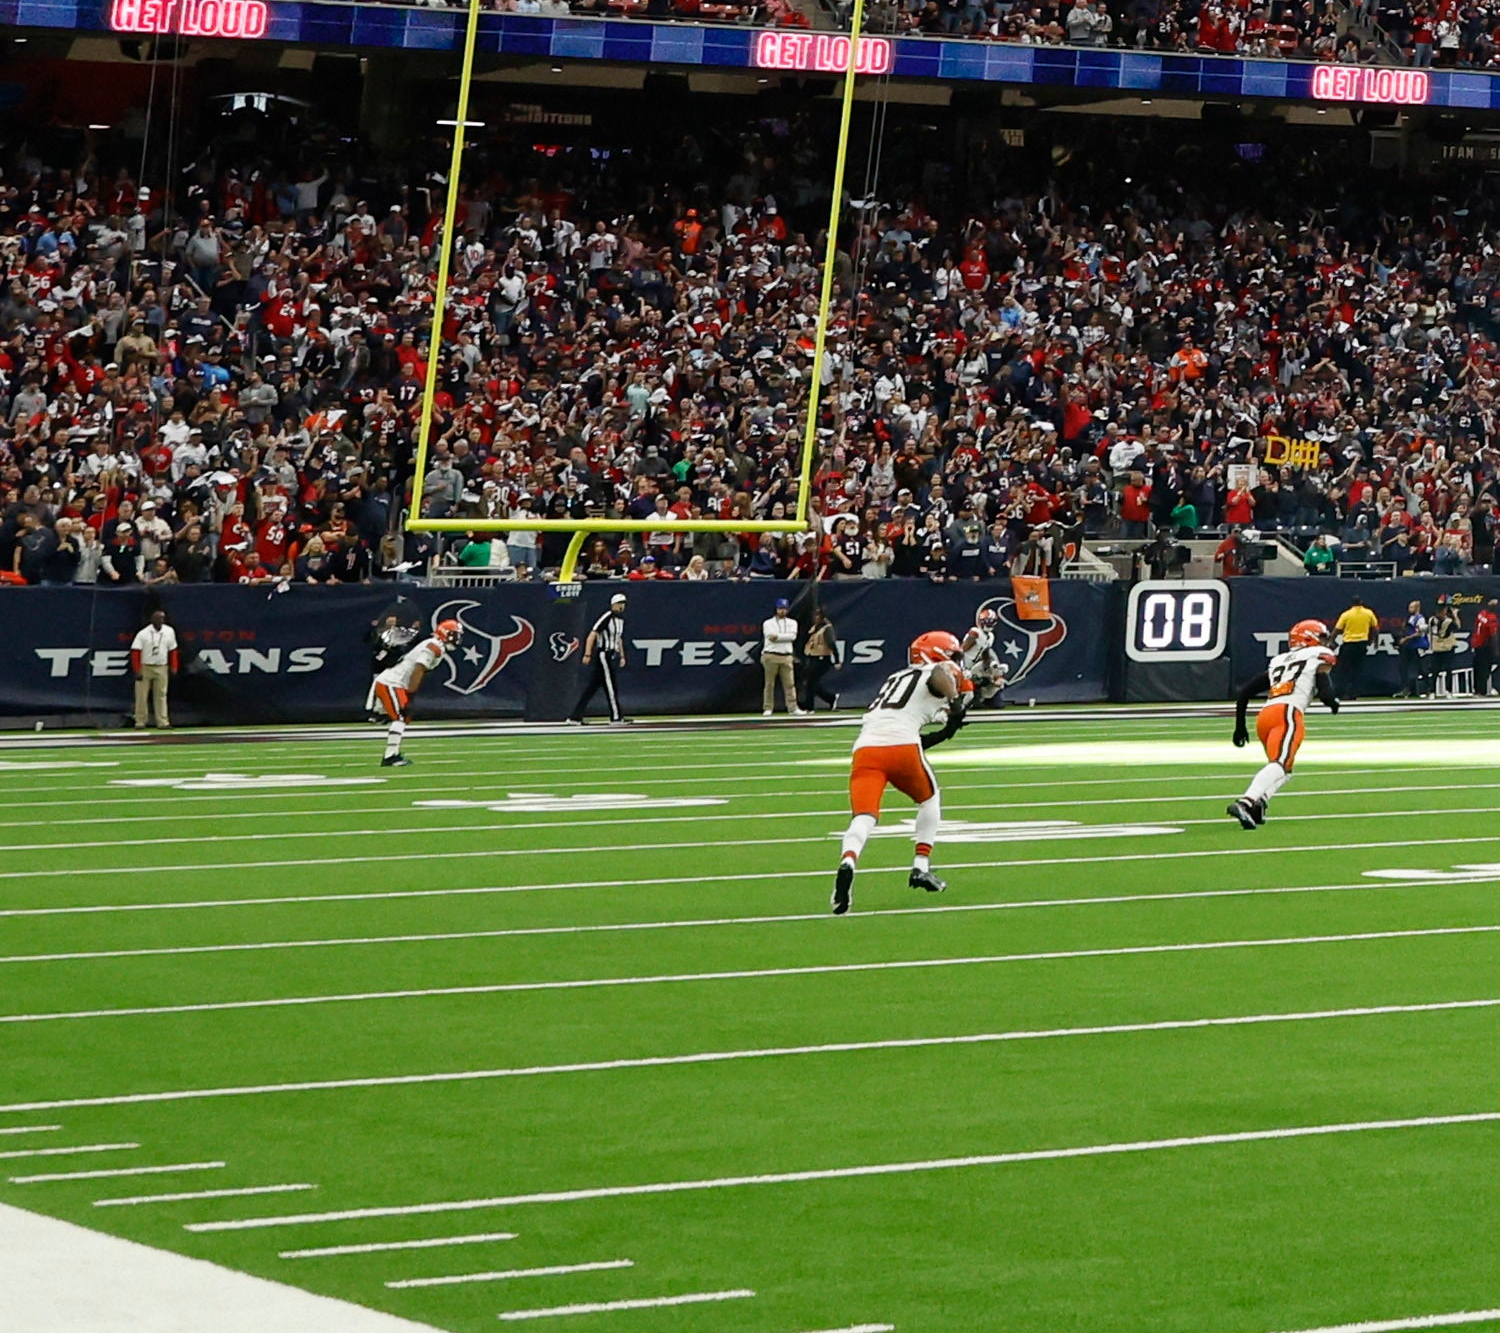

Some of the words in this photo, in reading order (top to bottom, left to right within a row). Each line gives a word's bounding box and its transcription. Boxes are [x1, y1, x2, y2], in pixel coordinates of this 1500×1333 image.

[757, 32, 814, 69] GET
[1313, 66, 1361, 100] GET
[1362, 69, 1427, 103] LOUD
[1442, 144, 1474, 159] TEAM
[400, 386, 416, 400] 17
[266, 525, 284, 544] 59
[845, 542, 859, 555] 51
[1142, 593, 1213, 648] 08
[35, 648, 326, 677] TEANS
[632, 640, 886, 666] TEXS
